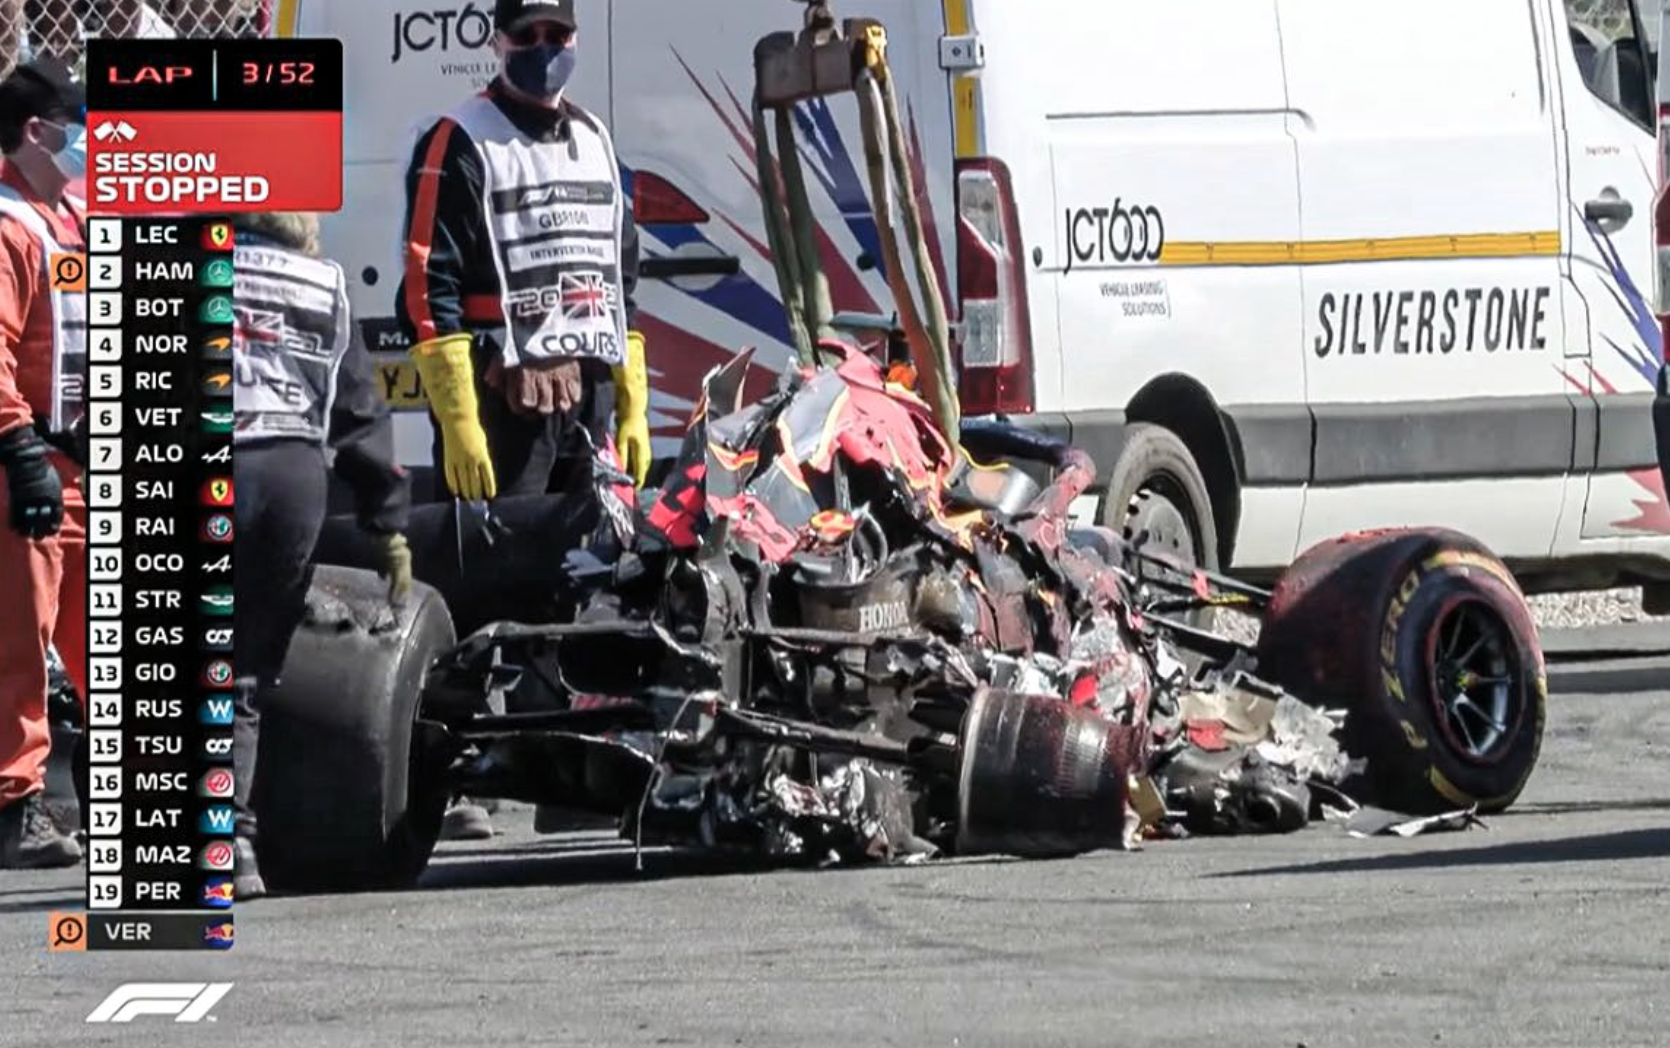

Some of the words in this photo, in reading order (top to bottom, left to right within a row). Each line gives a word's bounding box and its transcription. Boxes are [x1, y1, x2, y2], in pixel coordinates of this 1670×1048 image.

[391, 2, 496, 63] JCT6
[1121, 301, 1167, 317] SOLUTIONS
[1315, 286, 1550, 358] SILVERSTONE
[859, 601, 910, 632] HONDA
